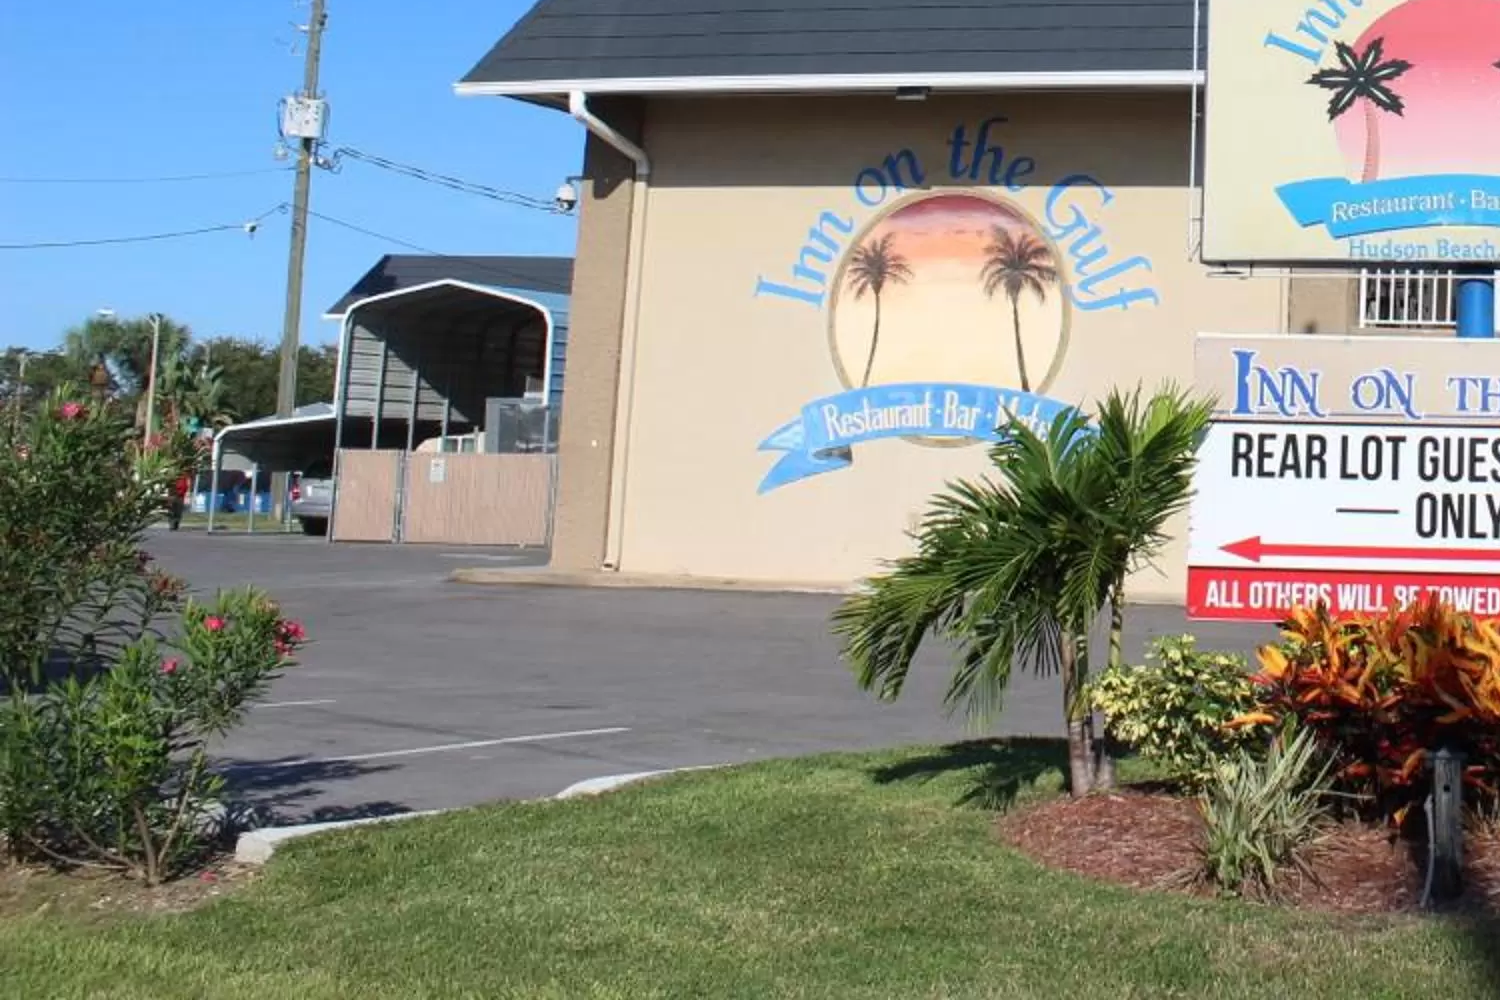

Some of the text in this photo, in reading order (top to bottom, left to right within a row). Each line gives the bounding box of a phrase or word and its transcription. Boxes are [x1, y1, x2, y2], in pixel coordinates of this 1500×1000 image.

[753, 118, 1163, 311] Inn on the Gulf
[1332, 191, 1454, 222] Restaurant
[1349, 238, 1428, 259] Hudson
[1436, 239, 1500, 260] Beach,
[823, 400, 933, 440] Restaurant
[943, 390, 981, 430] Bar
[1352, 369, 1422, 420] ON
[1232, 432, 1327, 479] REAR
[1340, 435, 1407, 481] LOT
[1205, 580, 1244, 608] ALL
[1249, 581, 1331, 611] OTHERS
[1337, 584, 1388, 612] WILL
